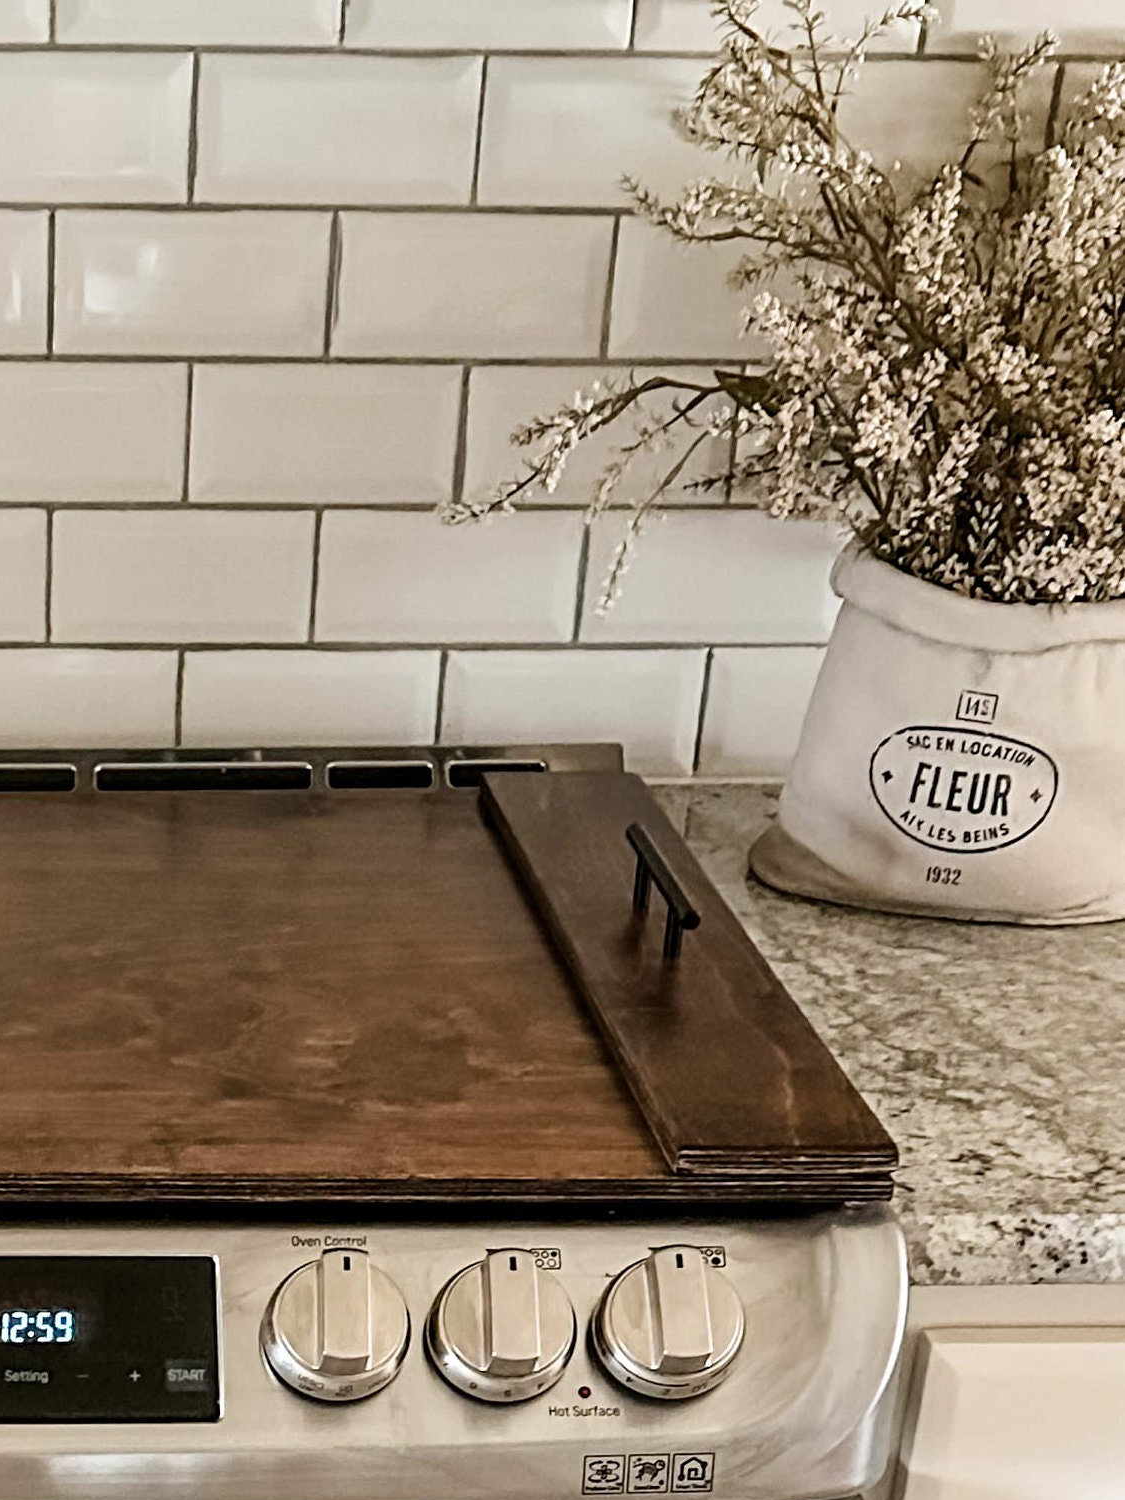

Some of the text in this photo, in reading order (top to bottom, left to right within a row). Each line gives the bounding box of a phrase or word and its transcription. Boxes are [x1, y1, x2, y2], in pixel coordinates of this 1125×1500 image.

[907, 735, 1036, 767] SAC EN LOCATION
[908, 761, 1012, 817] FLEUR
[928, 824, 956, 842] LES
[925, 866, 962, 886] 1932
[291, 1235, 367, 1247] Oven Control
[1, 1311, 73, 1343] 12:59
[4, 1370, 49, 1384] Setting
[167, 1368, 206, 1381] START
[548, 1405, 621, 1417] Hot Surface
